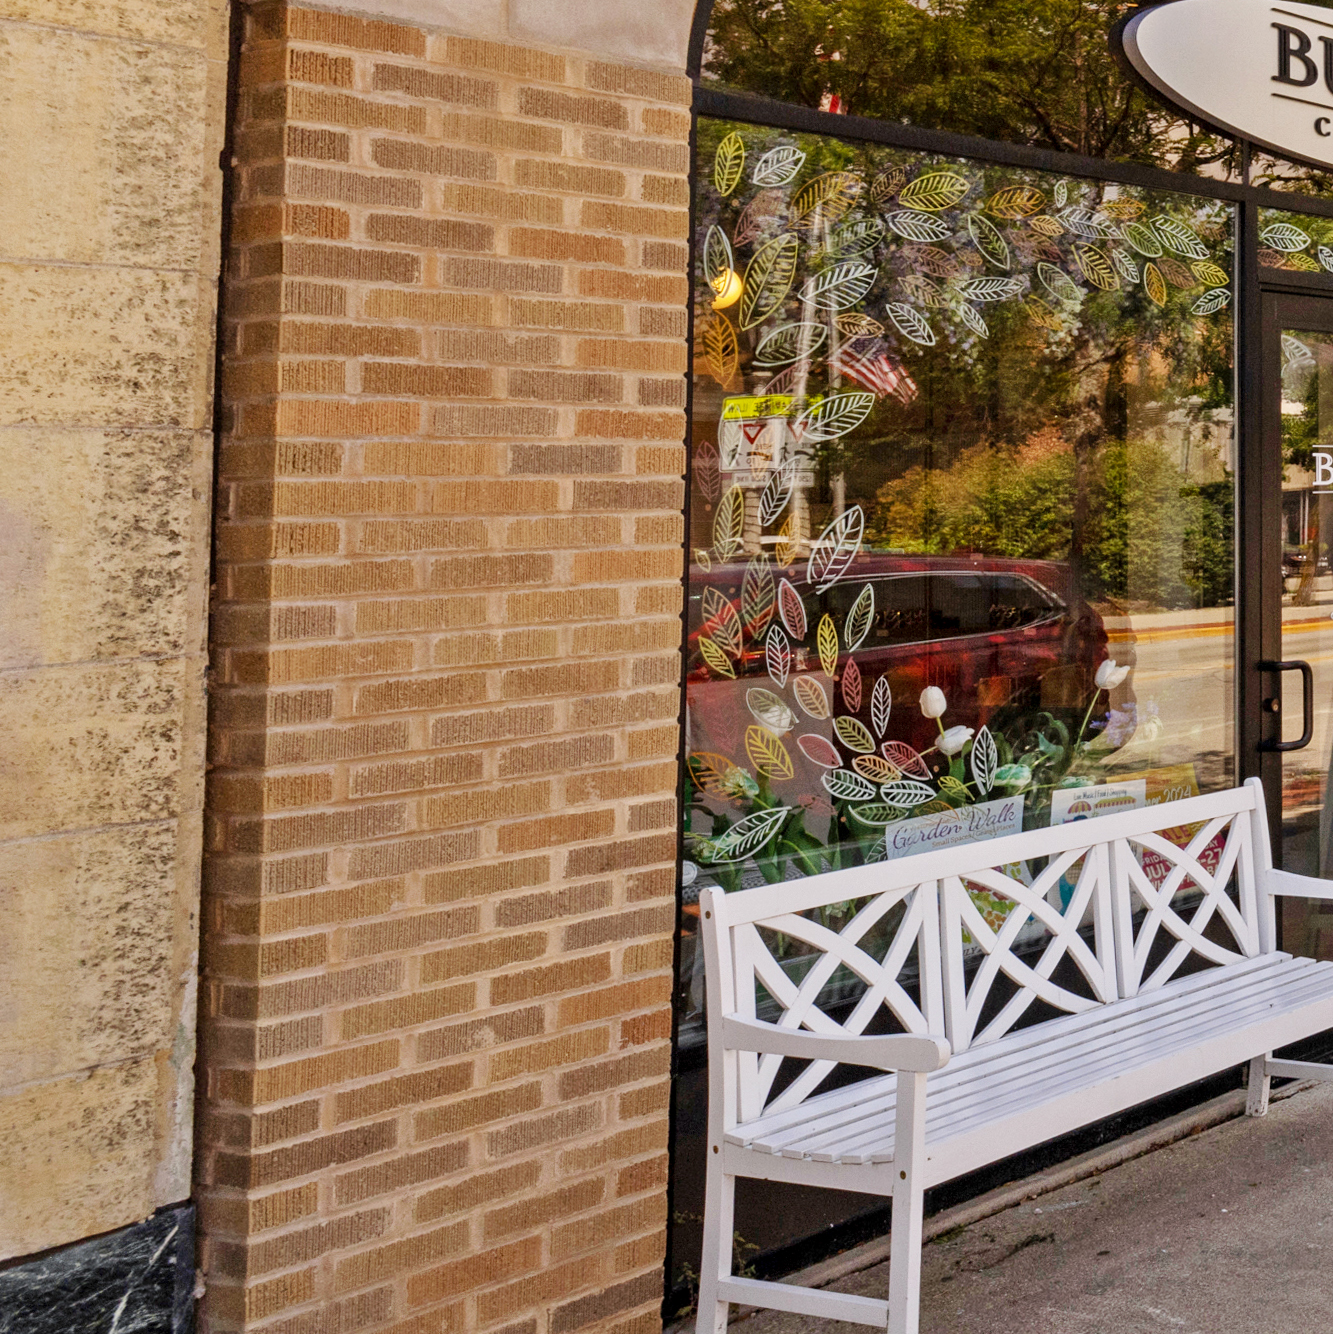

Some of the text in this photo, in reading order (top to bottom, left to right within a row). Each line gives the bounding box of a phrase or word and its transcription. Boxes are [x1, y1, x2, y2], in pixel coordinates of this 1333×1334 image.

[1163, 785, 1192, 803] 2024
[893, 802, 1016, 850] Garden Walk
[1161, 825, 1192, 842] ALE
